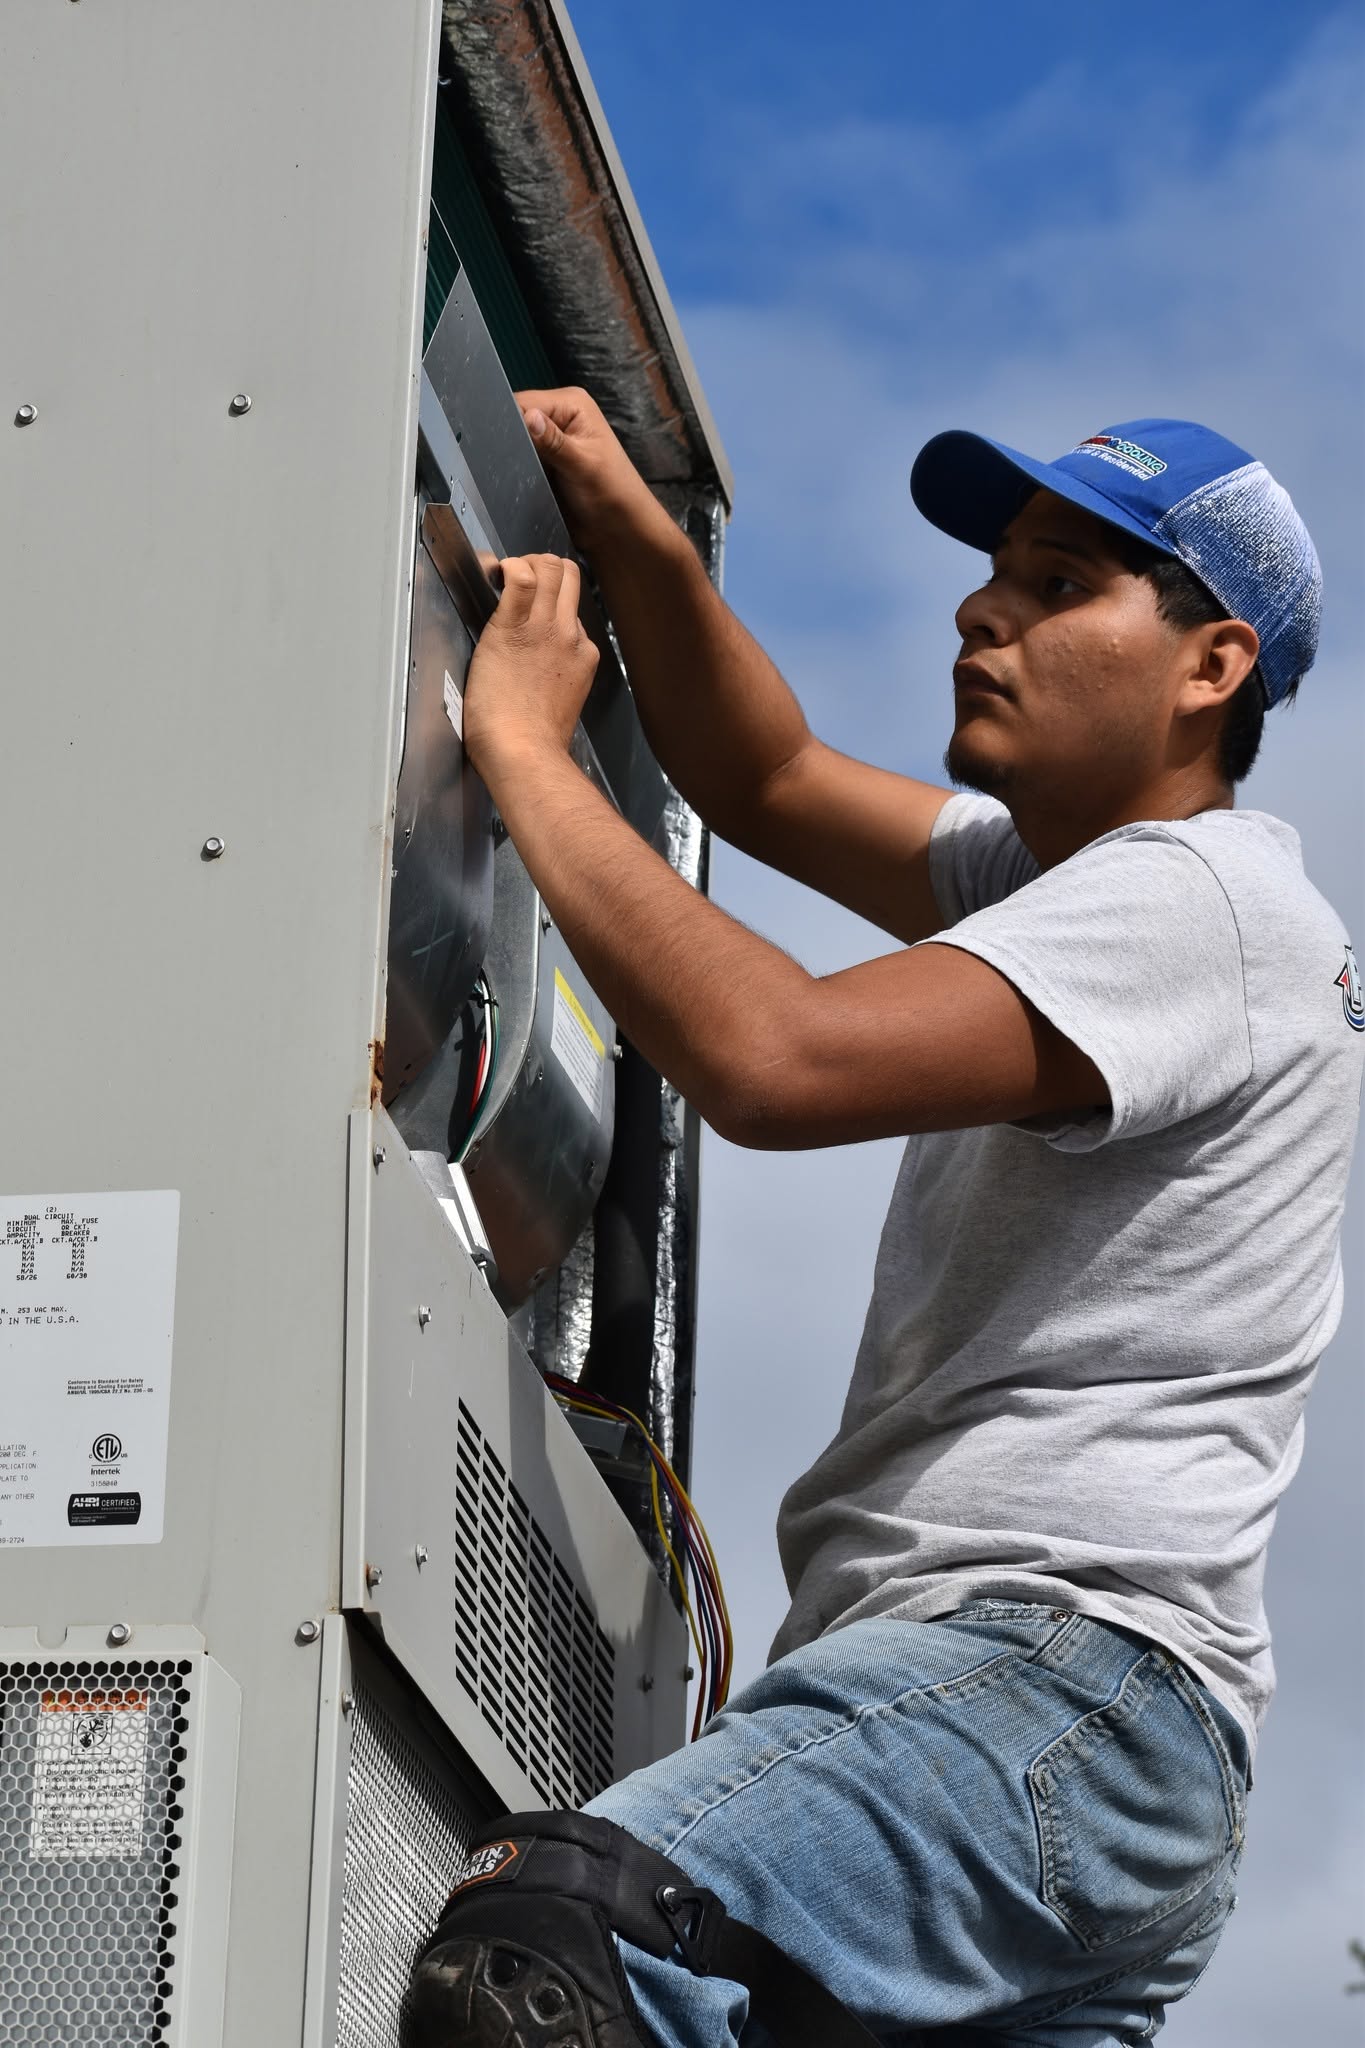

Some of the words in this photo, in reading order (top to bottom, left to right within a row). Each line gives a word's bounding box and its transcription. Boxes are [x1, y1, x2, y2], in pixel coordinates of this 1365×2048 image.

[1116, 442, 1163, 471] COOLING
[1098, 452, 1153, 481] Residential
[46, 1315, 79, 1324] U.S.A.
[96, 1437, 118, 1460] ETL
[91, 1467, 120, 1475] Intertek
[72, 1497, 99, 1507] AHRI
[101, 1499, 136, 1507] CERTIFIED
